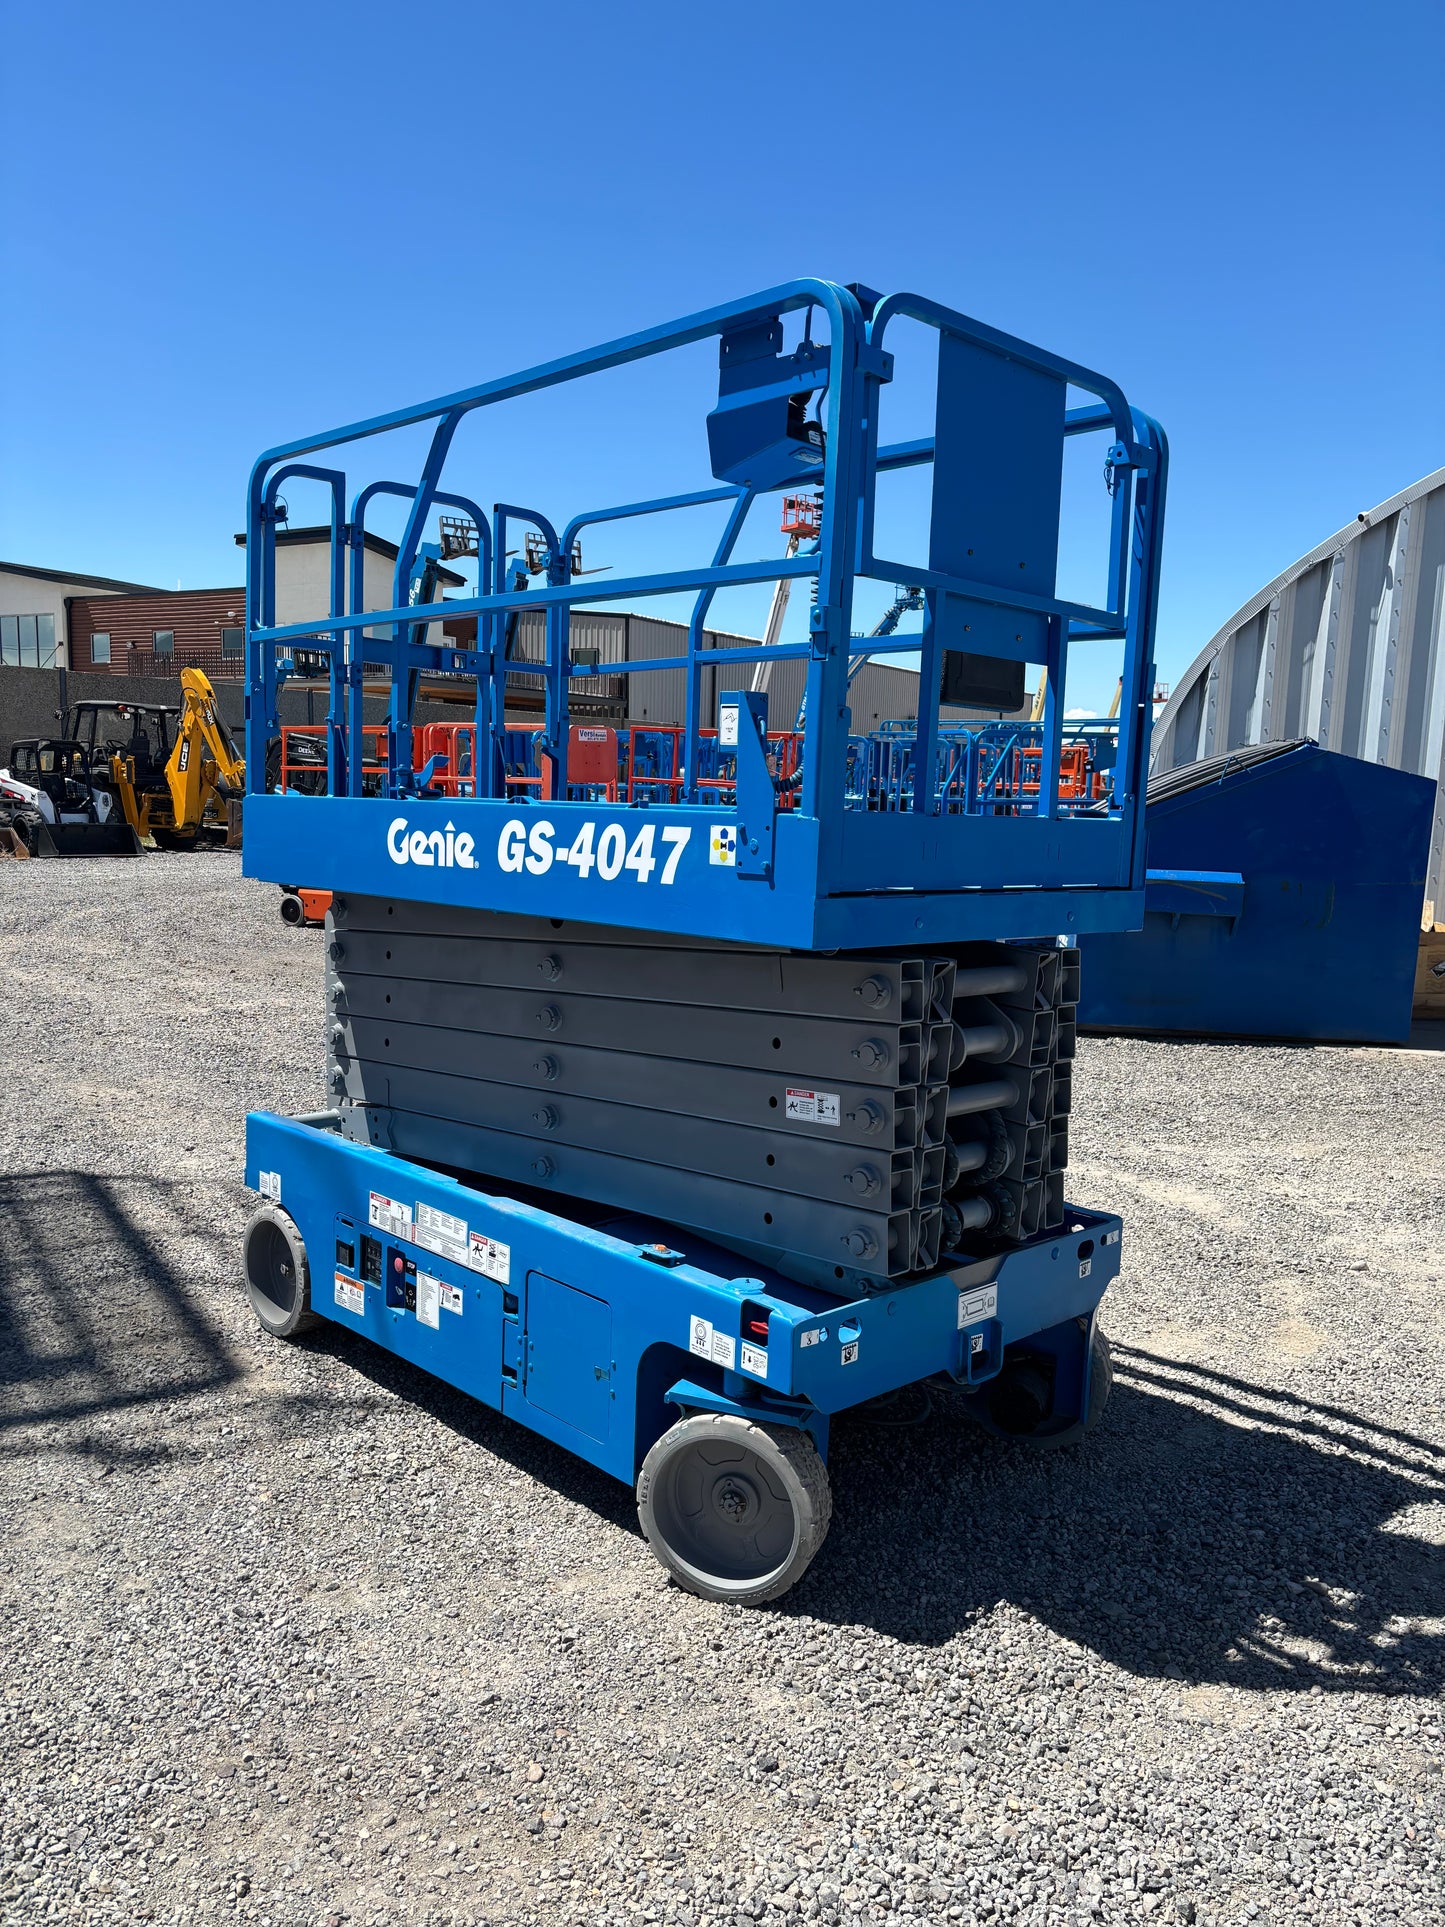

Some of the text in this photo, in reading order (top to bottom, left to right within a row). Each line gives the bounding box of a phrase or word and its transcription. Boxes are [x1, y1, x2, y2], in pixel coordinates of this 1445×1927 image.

[180, 742, 190, 771] JCB
[387, 817, 475, 868] Genie
[497, 819, 692, 885] GS-4047
